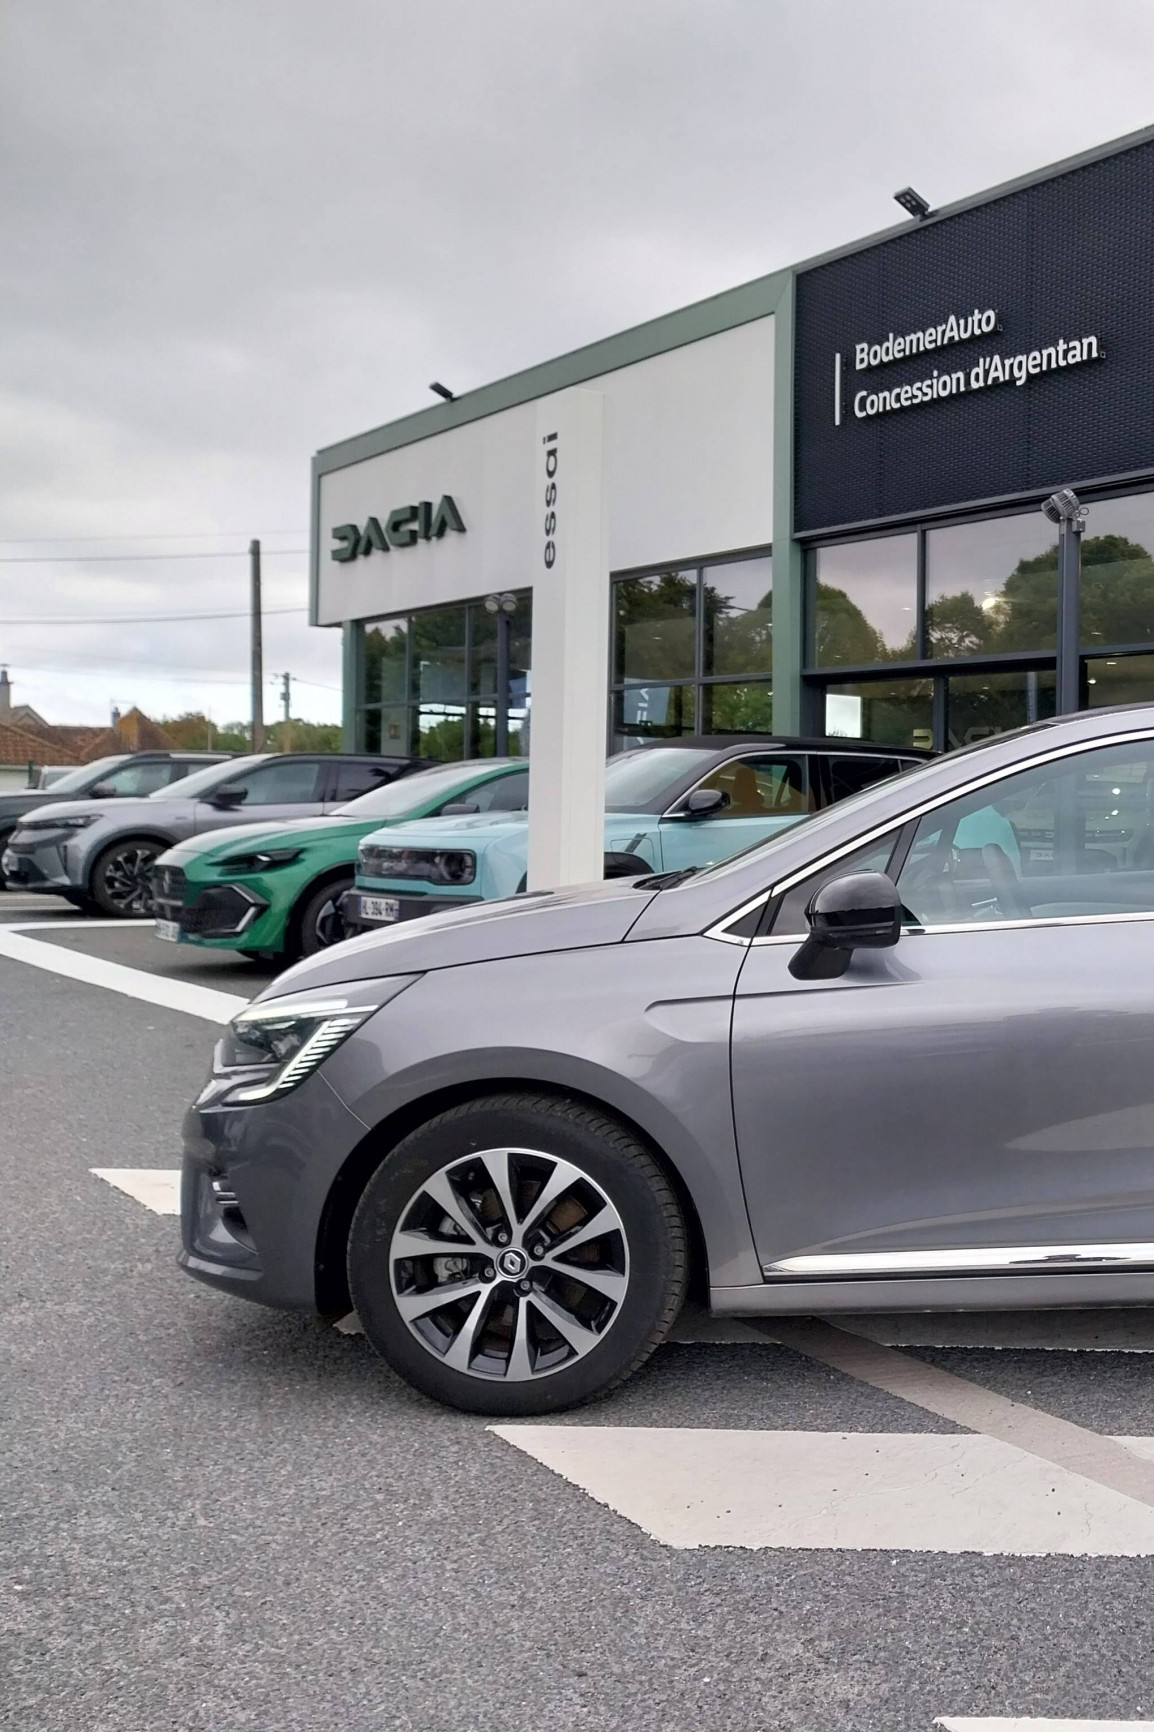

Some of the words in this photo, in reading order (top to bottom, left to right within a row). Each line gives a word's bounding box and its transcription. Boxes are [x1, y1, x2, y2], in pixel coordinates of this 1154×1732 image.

[853, 370, 966, 418] Concession
[970, 334, 1099, 387] d'Argentan
[855, 308, 996, 370] BodemerAuto
[331, 494, 467, 563] DACIA
[542, 431, 559, 570] essai
